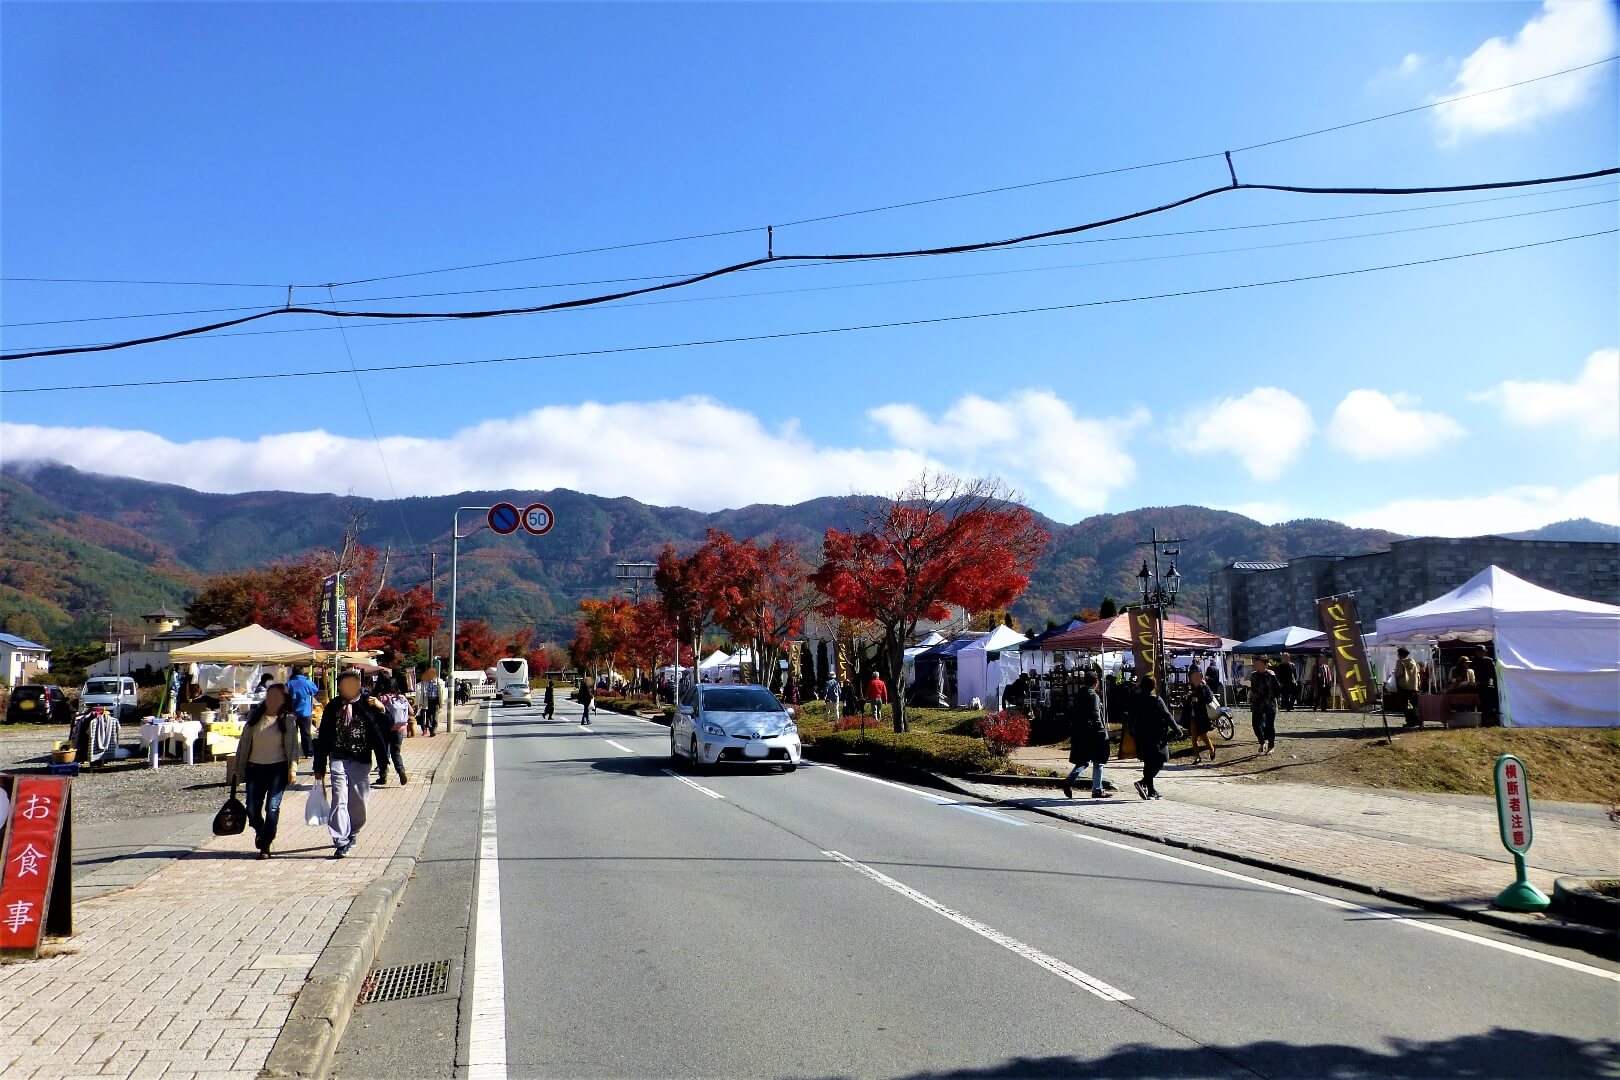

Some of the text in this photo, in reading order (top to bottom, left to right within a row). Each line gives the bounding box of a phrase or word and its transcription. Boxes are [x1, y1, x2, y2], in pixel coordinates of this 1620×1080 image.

[529, 512, 547, 526] 50
[1505, 764, 1525, 845] 横断者注意
[2, 793, 50, 933] お食事
